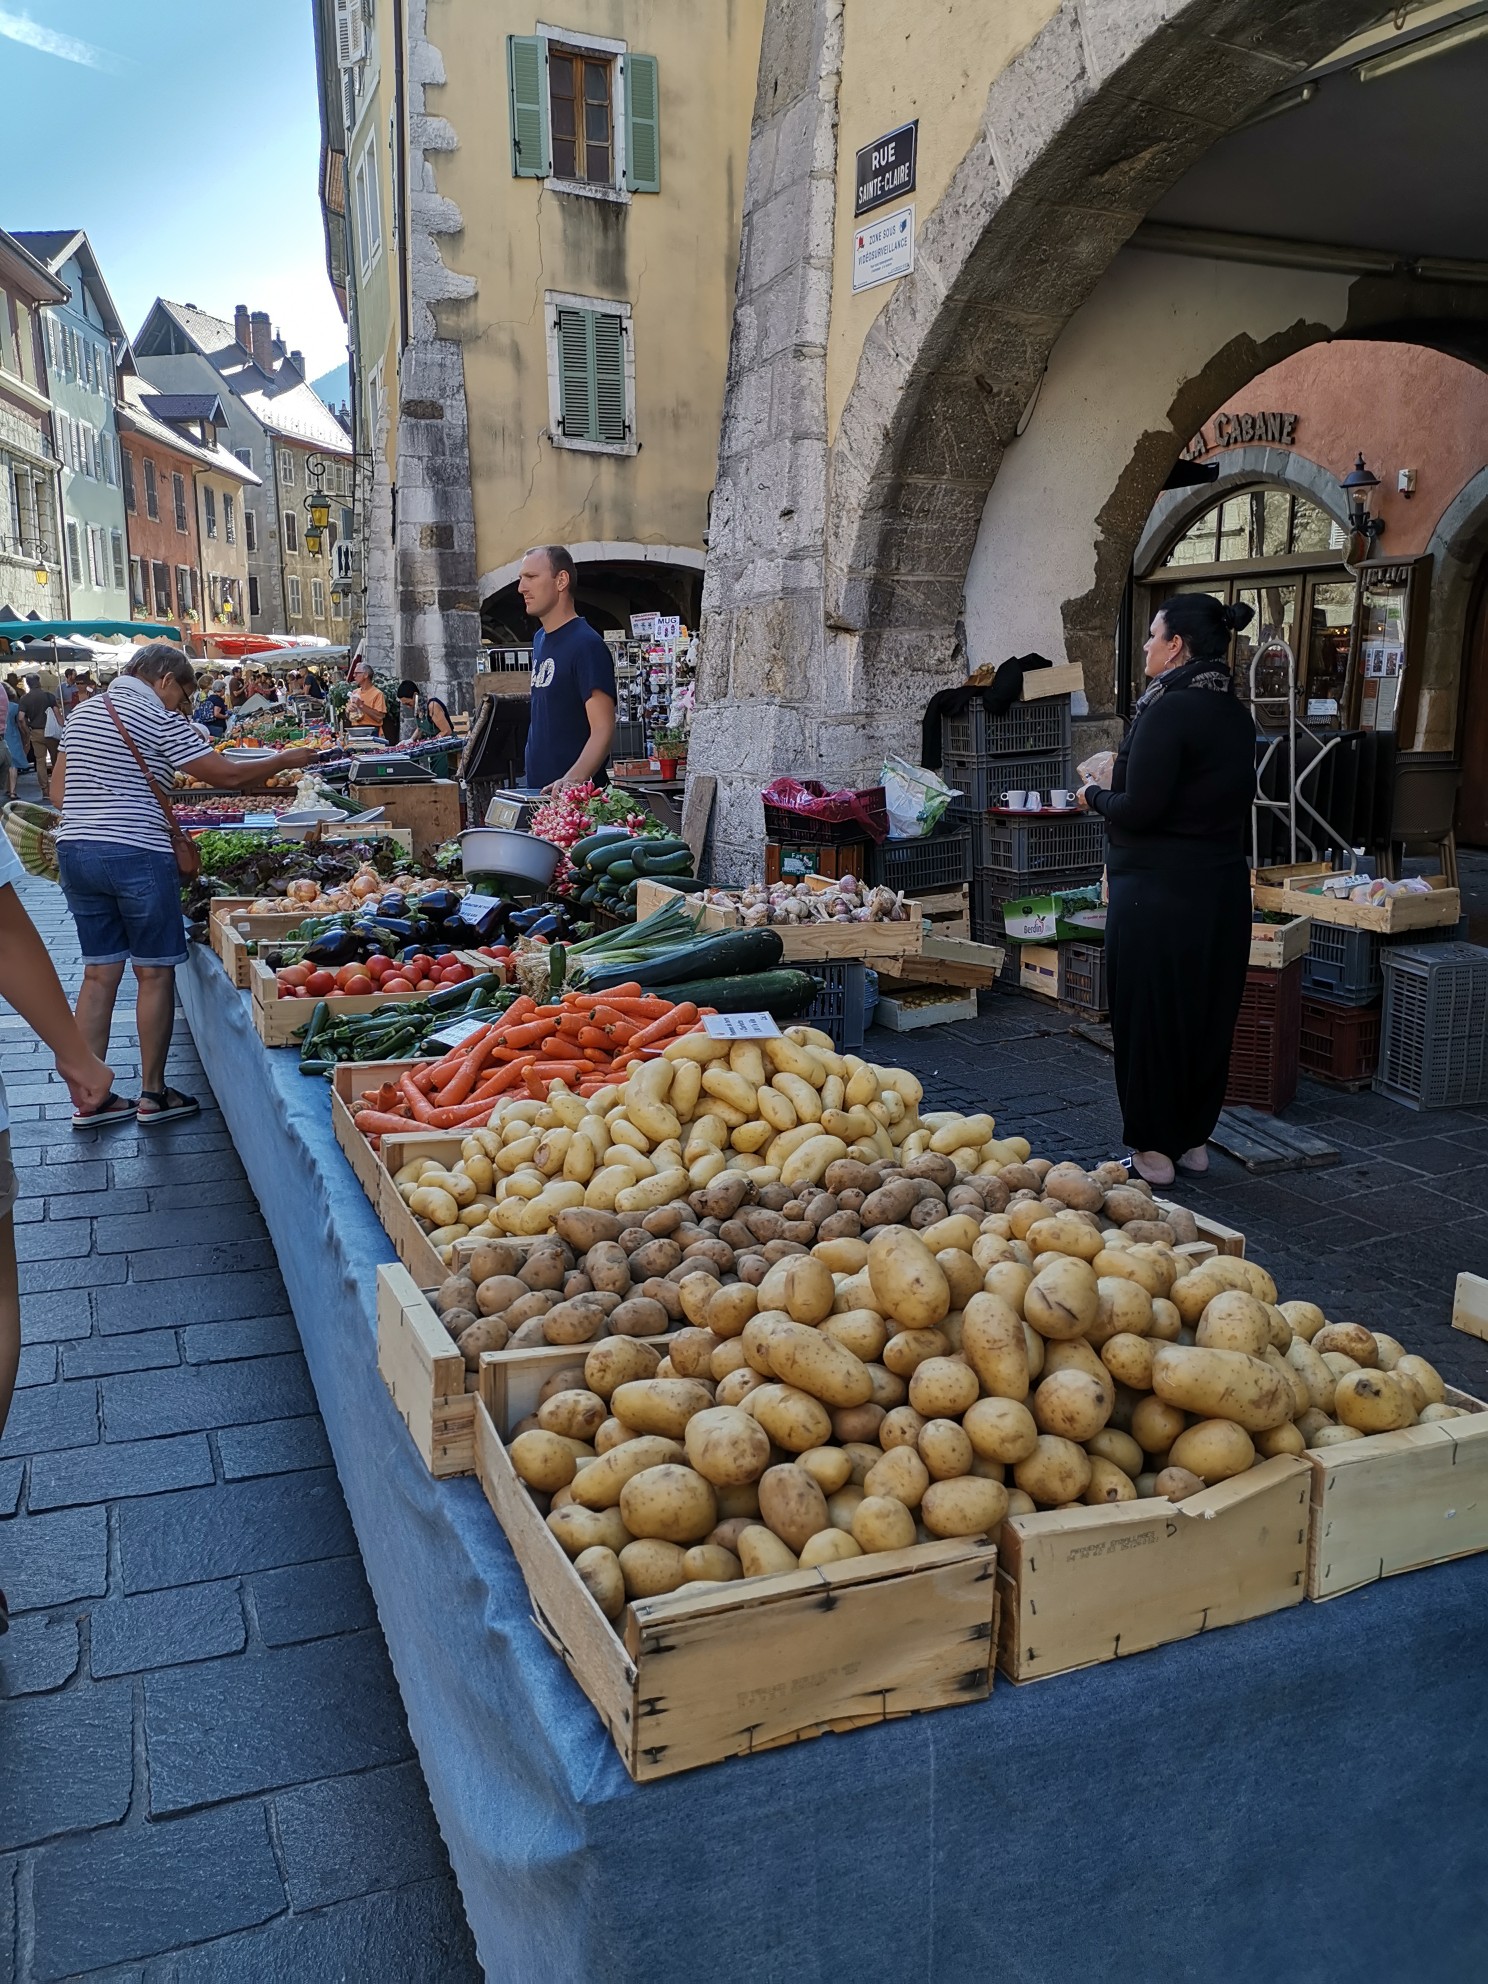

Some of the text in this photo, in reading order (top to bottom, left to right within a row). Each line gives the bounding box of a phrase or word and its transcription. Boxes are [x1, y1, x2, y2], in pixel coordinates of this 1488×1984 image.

[872, 142, 896, 171] RUE
[859, 162, 910, 204] SAINTE-CLAIRE
[869, 225, 896, 245] ZONE SOUS
[858, 237, 908, 266] VIDÉOSURVEILLANCE
[1214, 411, 1298, 447] CABANE
[658, 617, 677, 625] MUG
